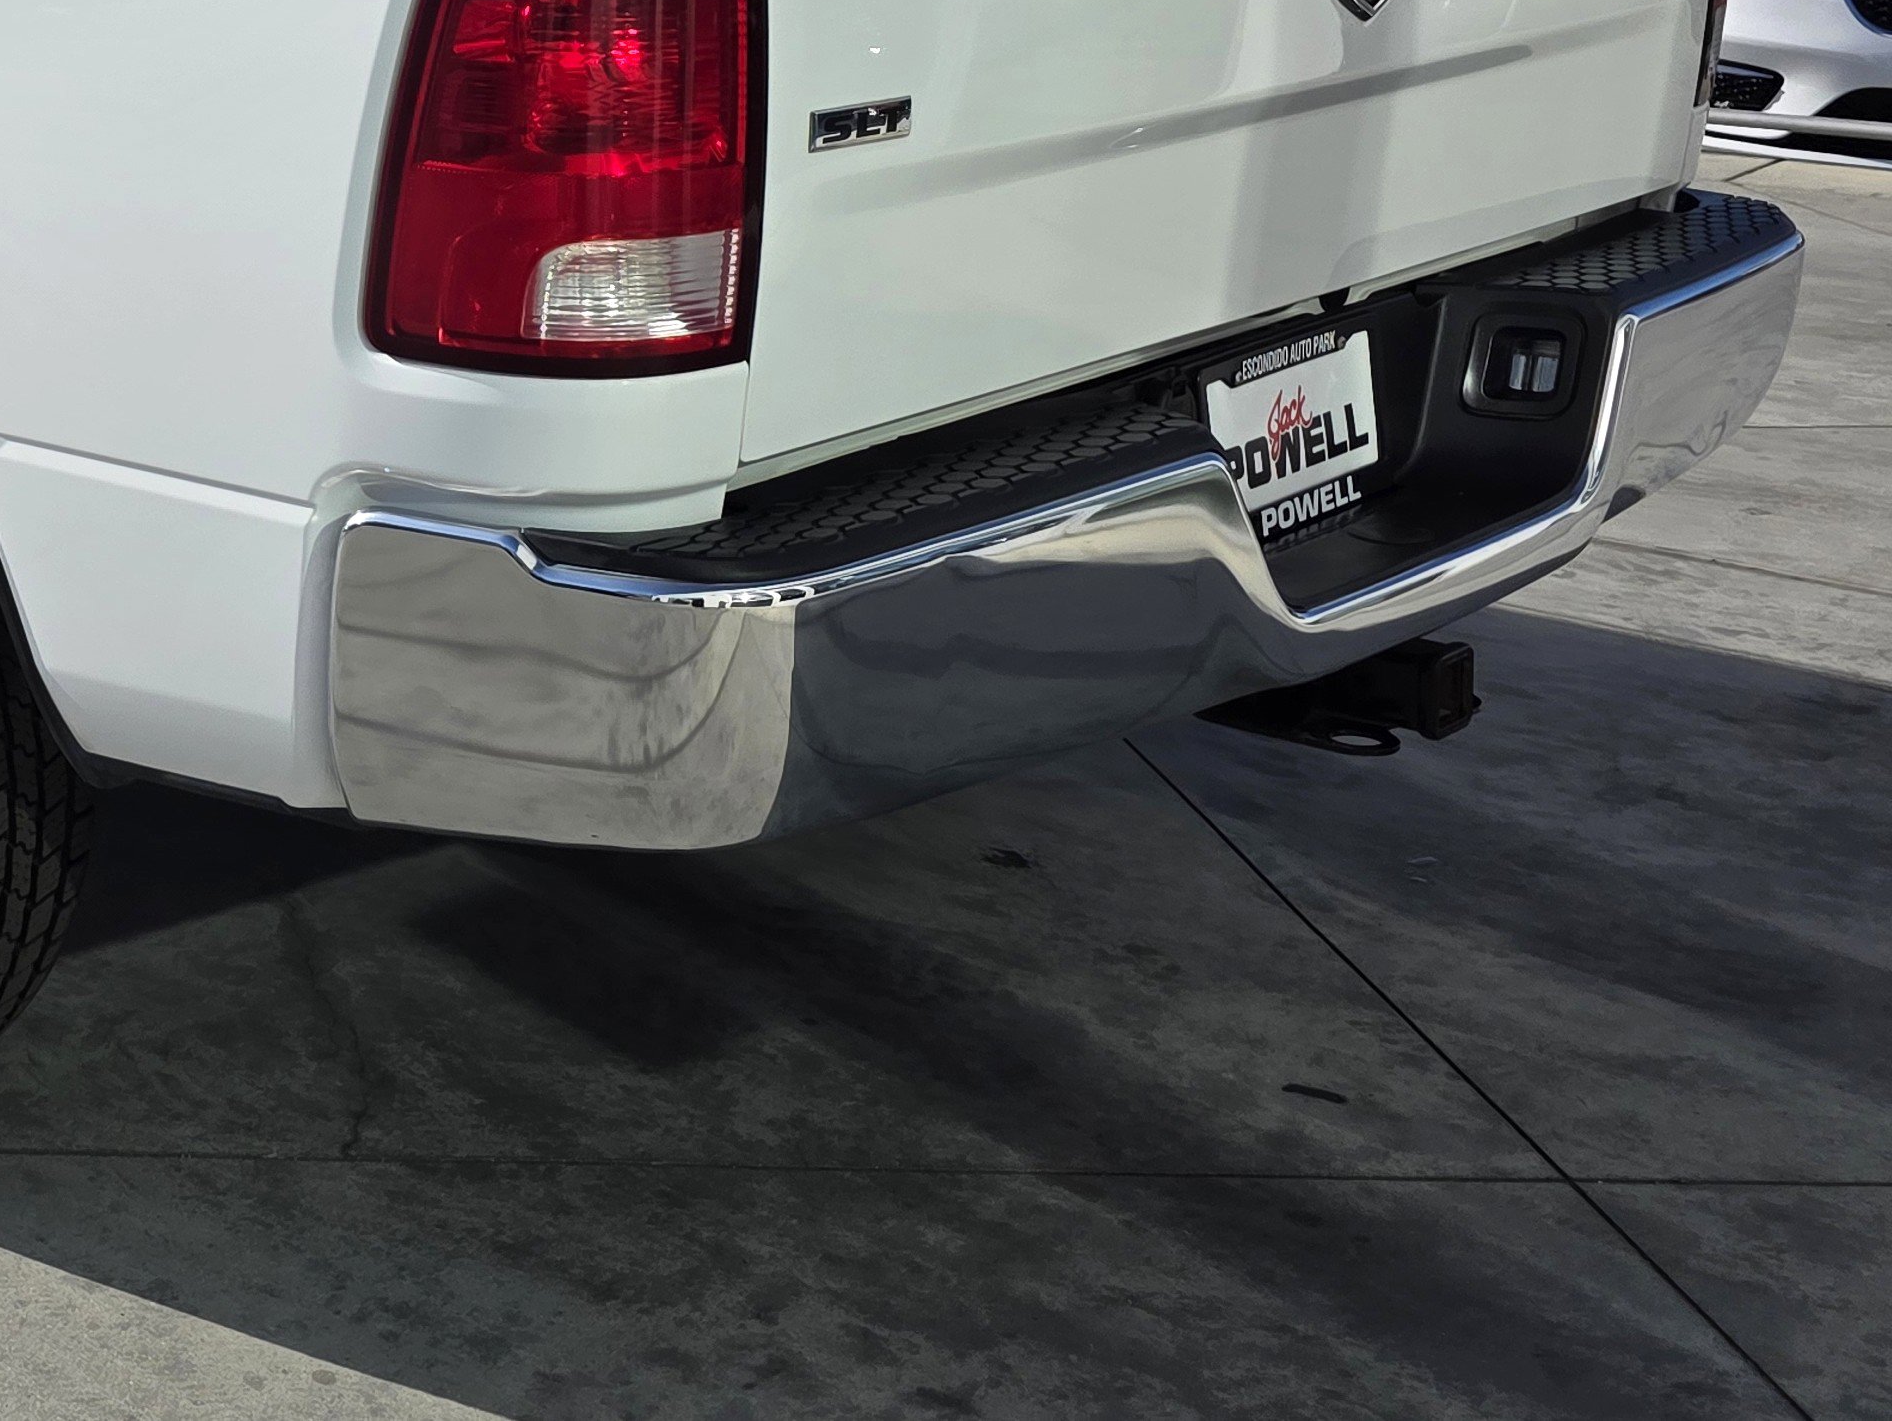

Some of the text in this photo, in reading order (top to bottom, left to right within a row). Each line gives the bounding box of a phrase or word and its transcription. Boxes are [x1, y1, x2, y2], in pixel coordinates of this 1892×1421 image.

[819, 105, 905, 145] SLT
[1242, 330, 1336, 381] ESCONDIDO AUTO PARK
[1224, 402, 1369, 489] POWELL
[1267, 385, 1313, 462] Jack
[1261, 475, 1362, 537] POWELL
